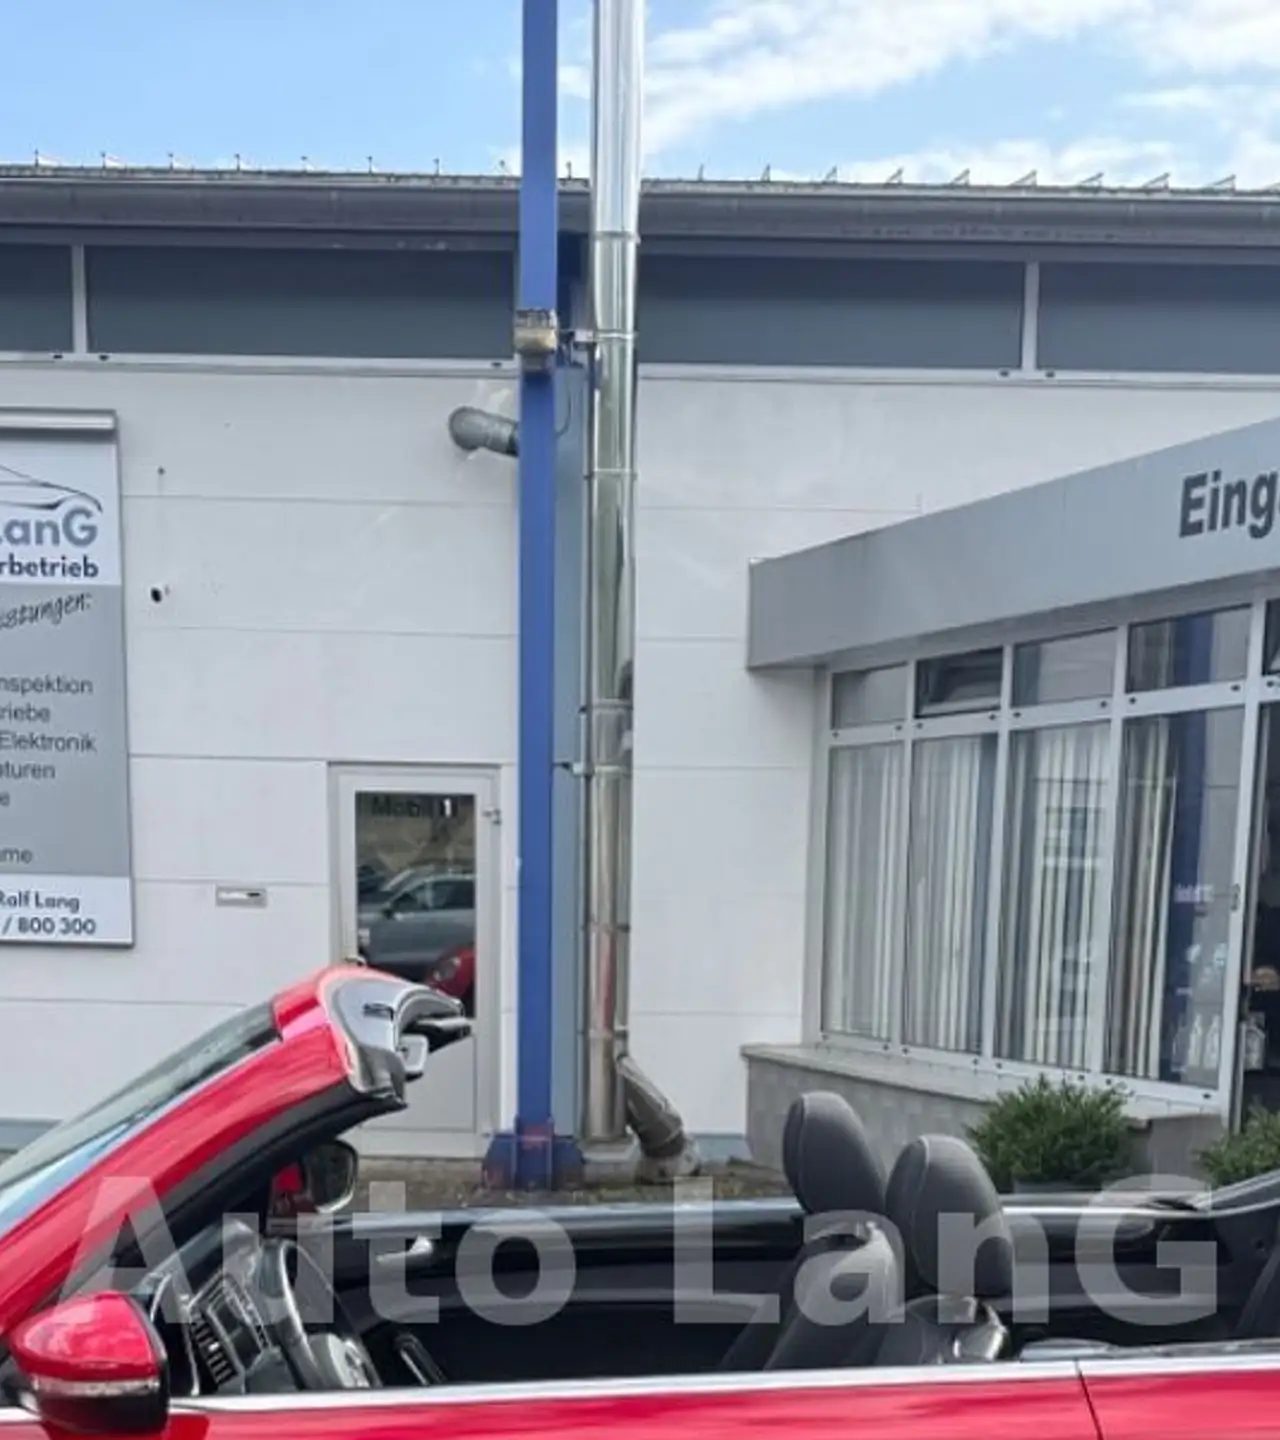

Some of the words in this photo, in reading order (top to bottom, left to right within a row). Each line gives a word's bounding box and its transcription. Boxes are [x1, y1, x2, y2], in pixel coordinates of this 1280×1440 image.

[35, 890, 80, 912] Lang
[18, 916, 54, 934] 800
[60, 917, 96, 936] 300
